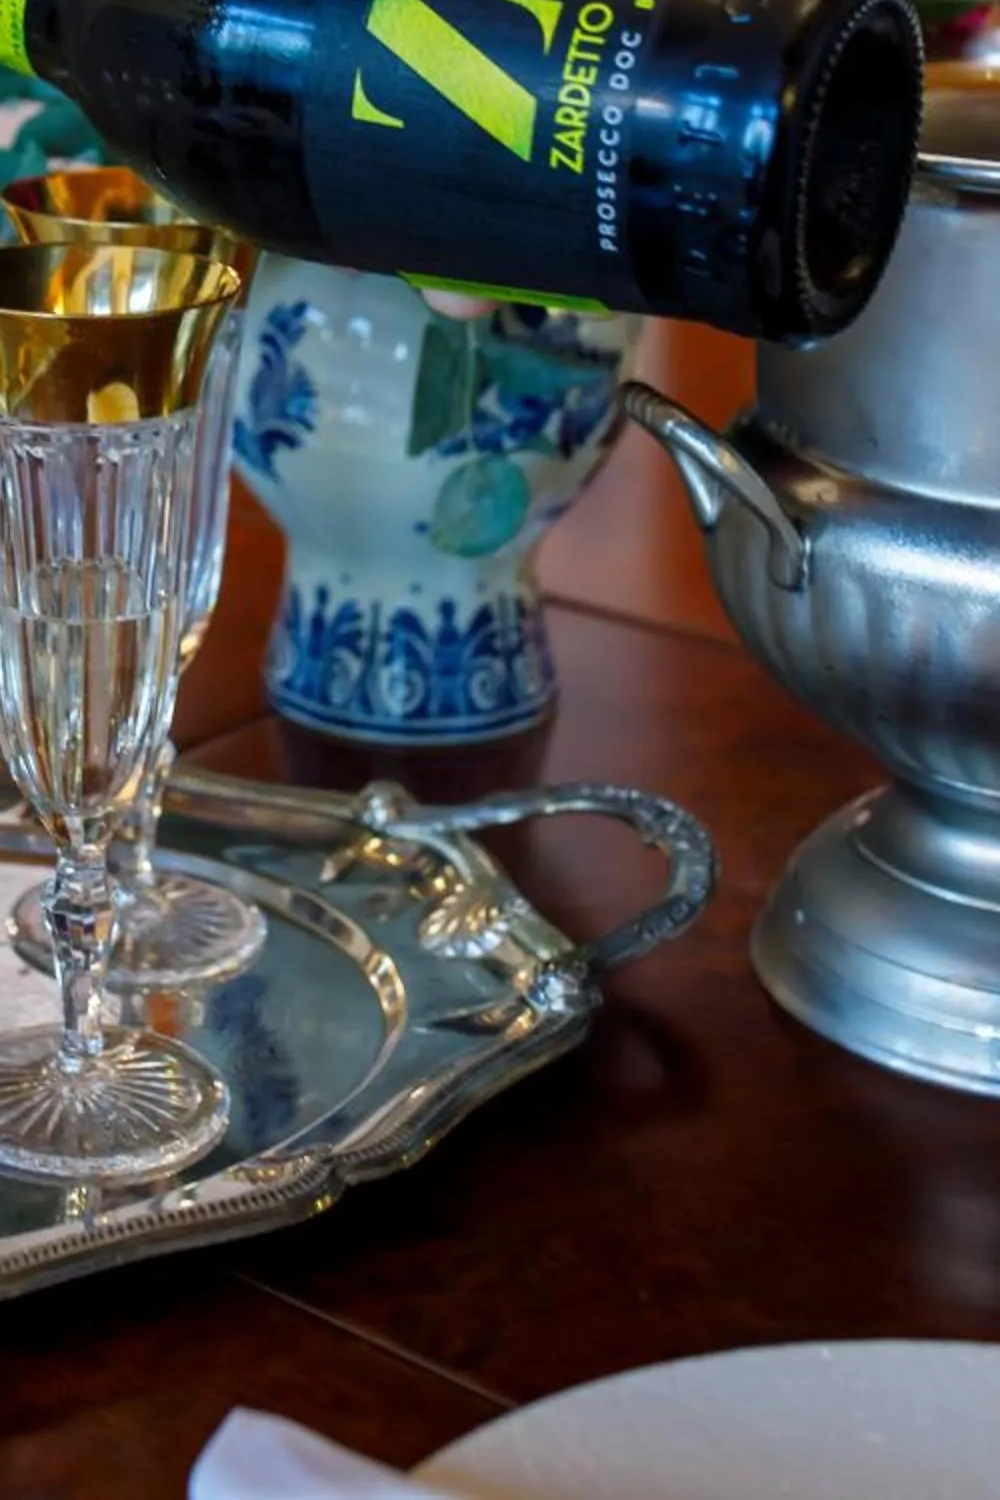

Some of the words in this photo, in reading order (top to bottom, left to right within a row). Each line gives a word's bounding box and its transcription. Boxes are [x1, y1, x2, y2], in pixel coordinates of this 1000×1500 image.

[549, 2, 613, 174] ZARDETTO
[609, 31, 642, 91] DOC
[596, 105, 624, 251] PROSECCO
